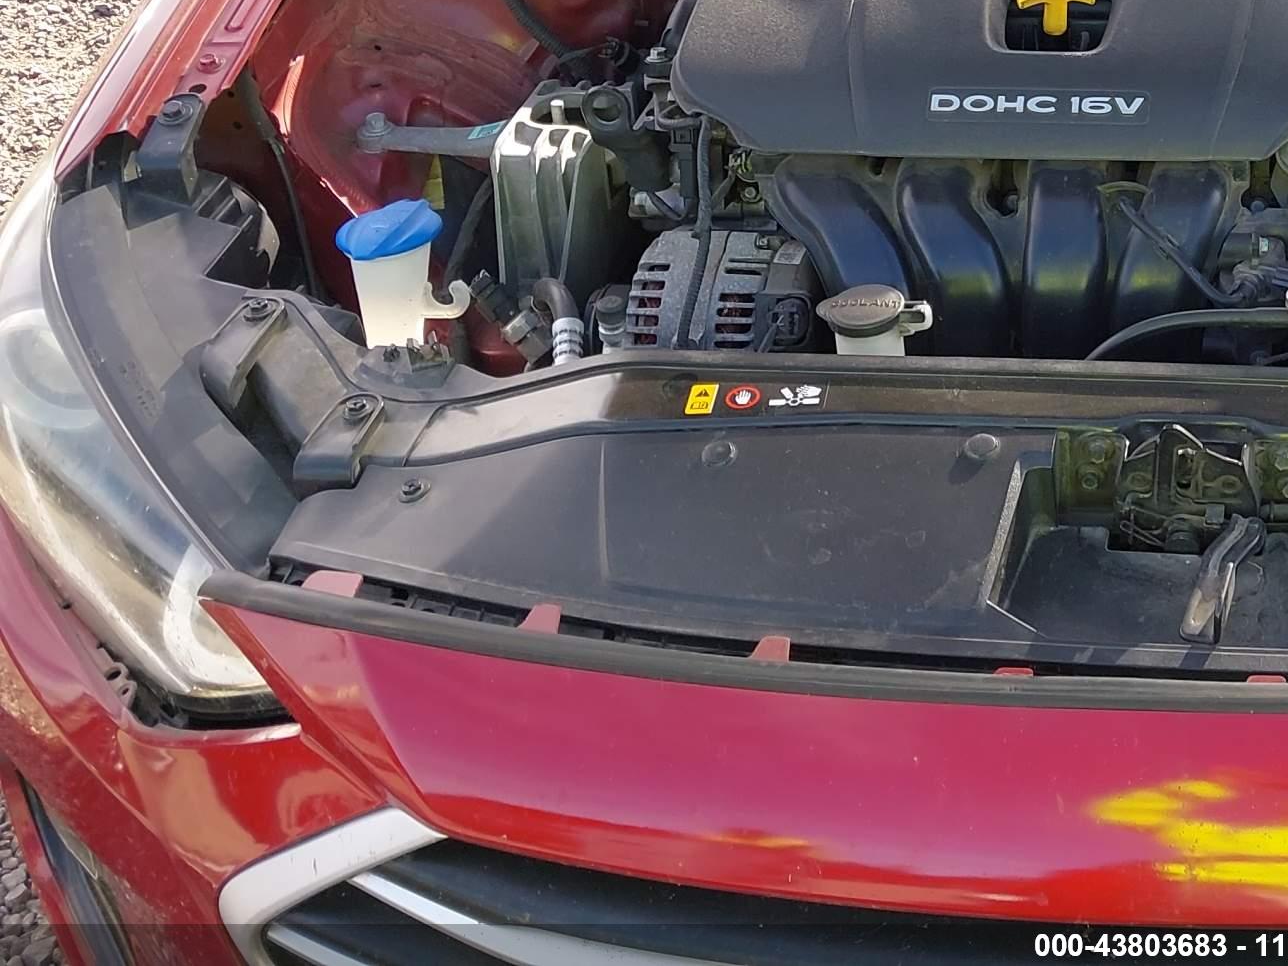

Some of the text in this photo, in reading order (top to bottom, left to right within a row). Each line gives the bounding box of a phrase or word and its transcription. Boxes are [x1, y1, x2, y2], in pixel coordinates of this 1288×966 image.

[930, 94, 1145, 115] DOHC 16V
[831, 298, 899, 309] COOLANT
